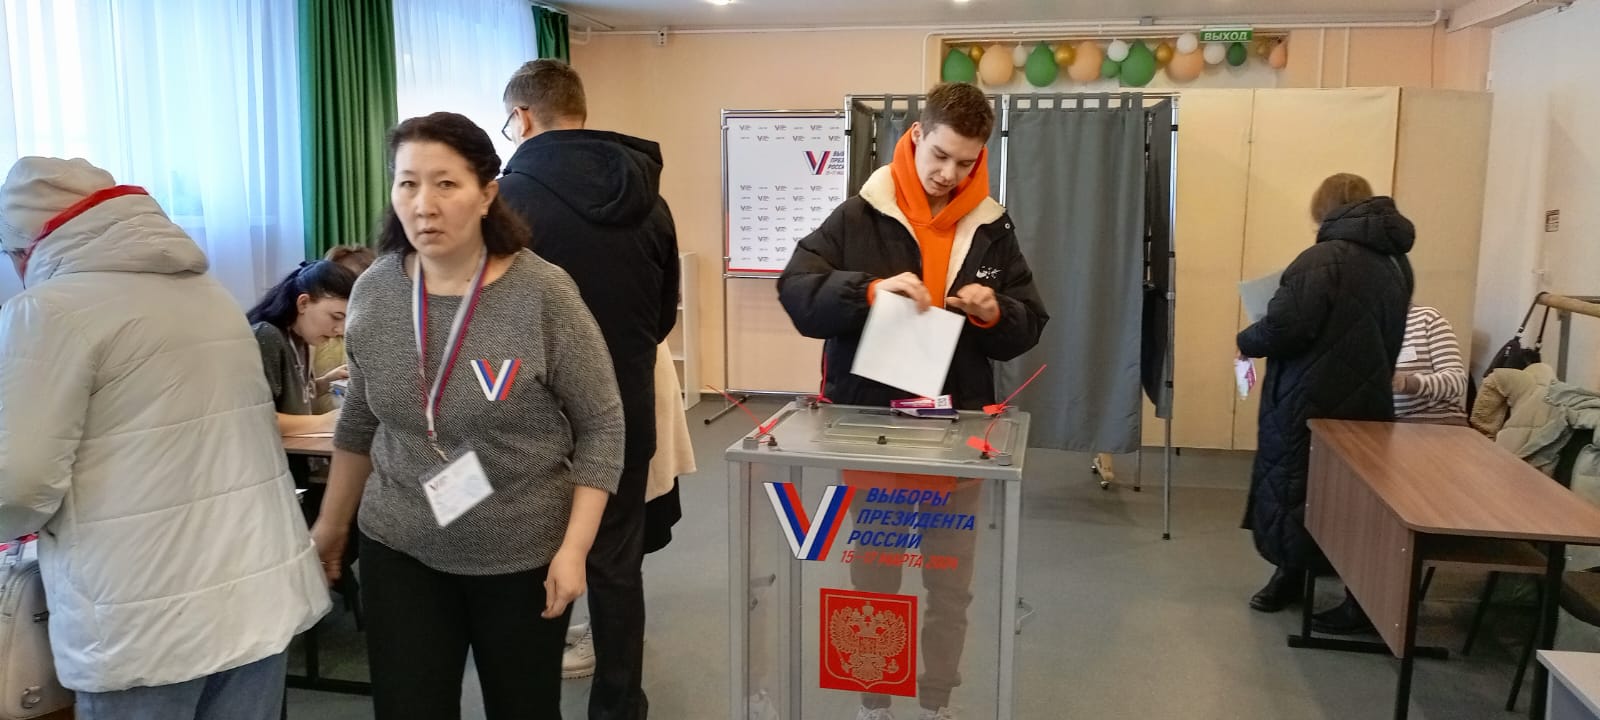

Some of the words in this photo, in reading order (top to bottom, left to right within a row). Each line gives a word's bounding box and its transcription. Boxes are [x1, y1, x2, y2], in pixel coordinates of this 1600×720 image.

[1204, 31, 1248, 41] ВЫХОД
[866, 487, 952, 506] ВЫБОРЫ
[857, 509, 976, 530] ПРЕЗИДЕНТА
[847, 530, 922, 549] РОССИИ
